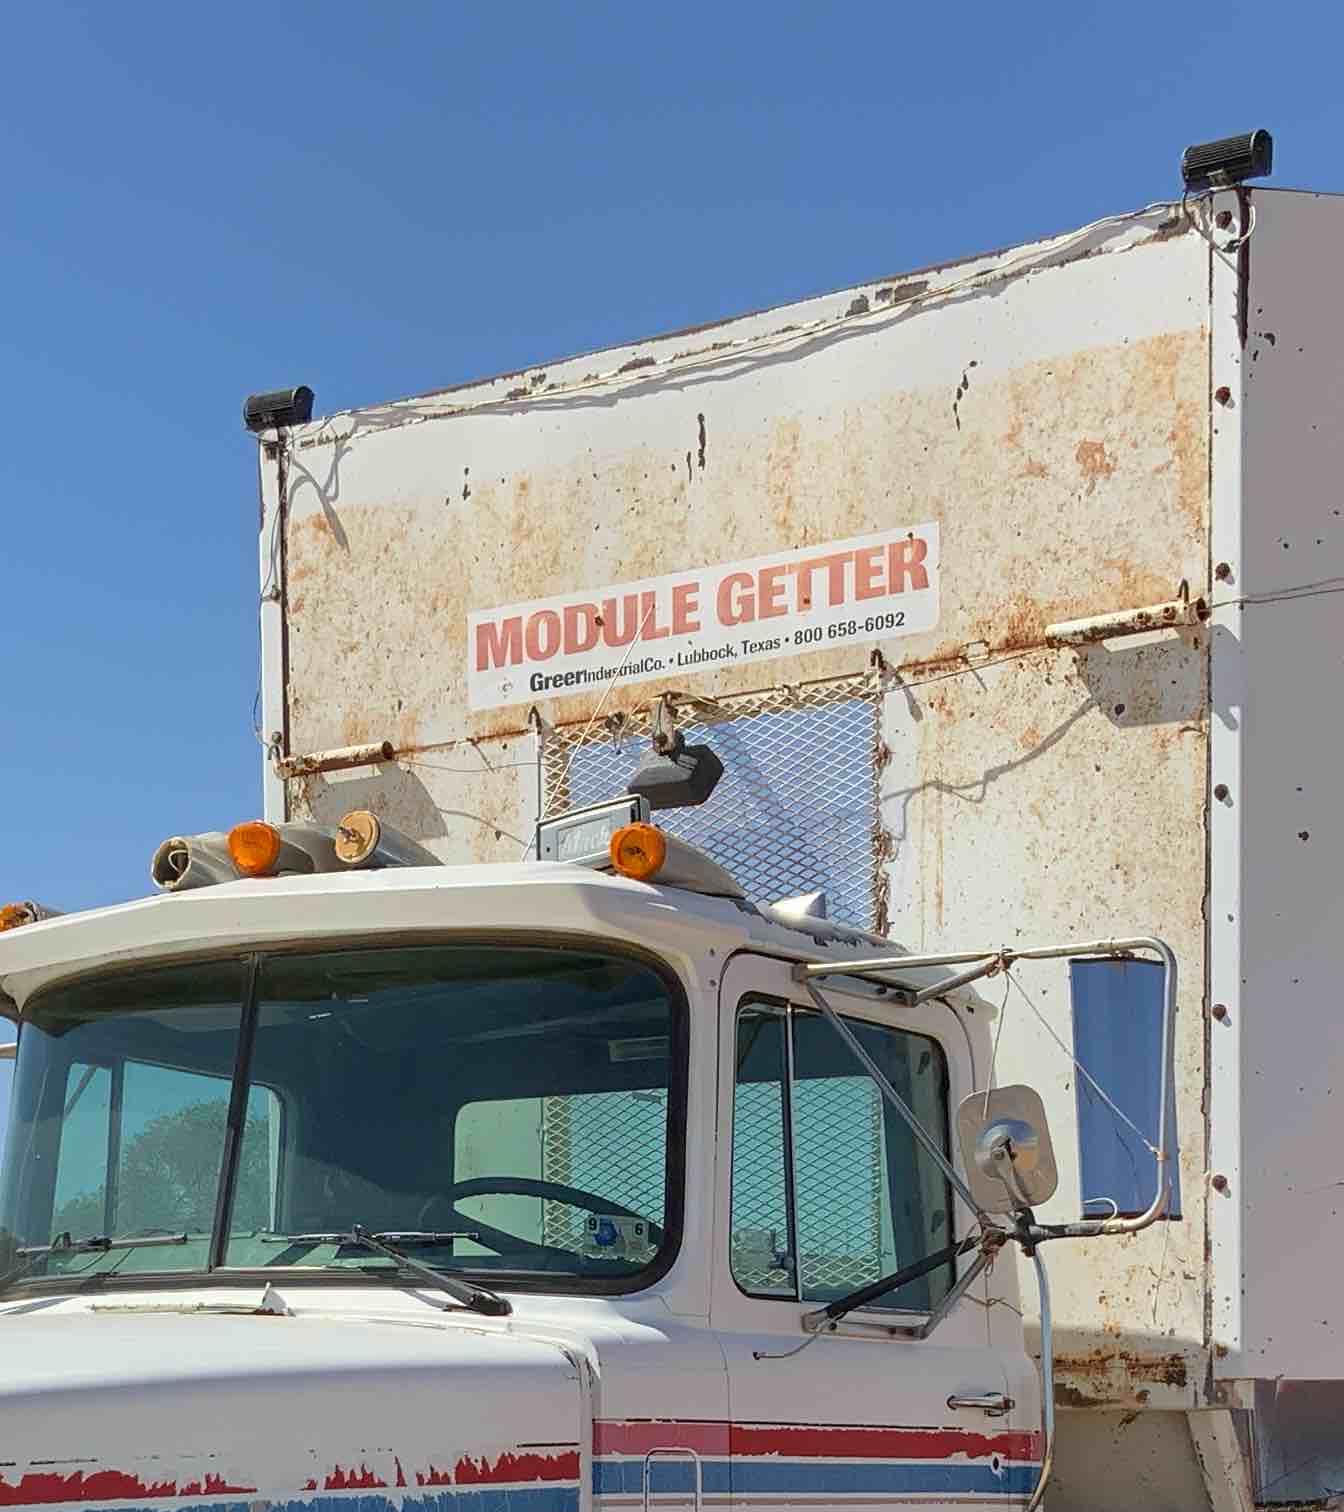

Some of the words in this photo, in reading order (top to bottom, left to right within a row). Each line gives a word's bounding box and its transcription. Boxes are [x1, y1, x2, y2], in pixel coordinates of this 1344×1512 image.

[475, 582, 701, 672] MODULE
[716, 538, 930, 627] GETTER
[677, 643, 738, 667] Lubbock,
[742, 636, 781, 656] Texas
[794, 627, 823, 645] 800
[828, 611, 906, 639] 658-6092
